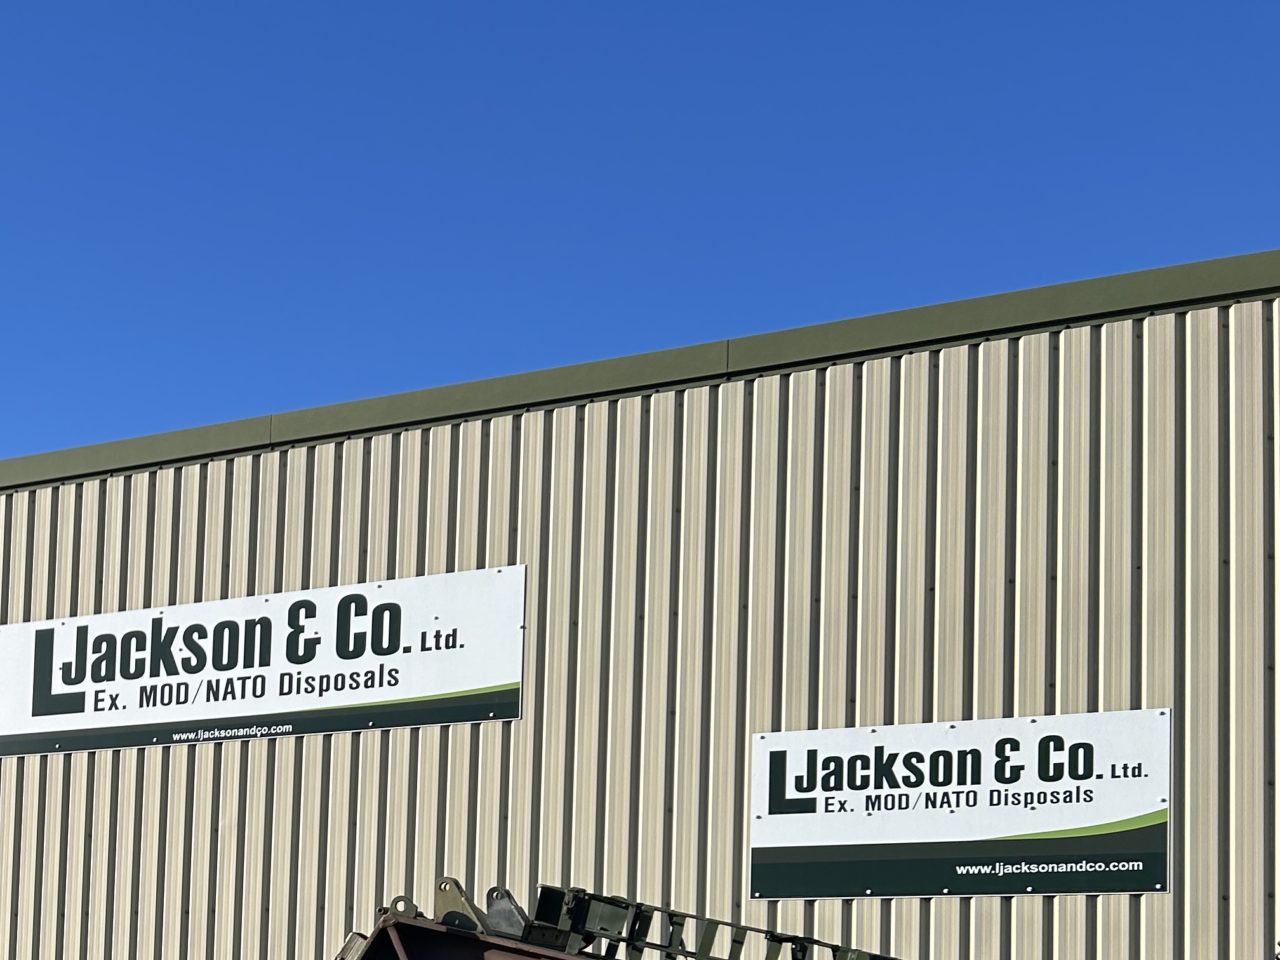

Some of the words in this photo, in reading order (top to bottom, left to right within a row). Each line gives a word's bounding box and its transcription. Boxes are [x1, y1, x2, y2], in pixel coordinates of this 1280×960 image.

[285, 600, 321, 666] &
[335, 594, 413, 661] Co.
[420, 628, 465, 653] Ltd.
[93, 689, 127, 713] Ex.
[138, 675, 266, 709] MOD/NATO
[279, 665, 400, 698] Disposals
[172, 723, 293, 741] www.ljacksonandco.com
[994, 738, 1025, 785] &
[1037, 735, 1104, 782] Co.
[1110, 762, 1149, 779] Ltd.
[824, 796, 854, 813] Ex.
[865, 790, 978, 812] MOD/NATO
[989, 785, 1094, 810] Disposals
[955, 860, 1143, 876] www.ljacksonandco.com
